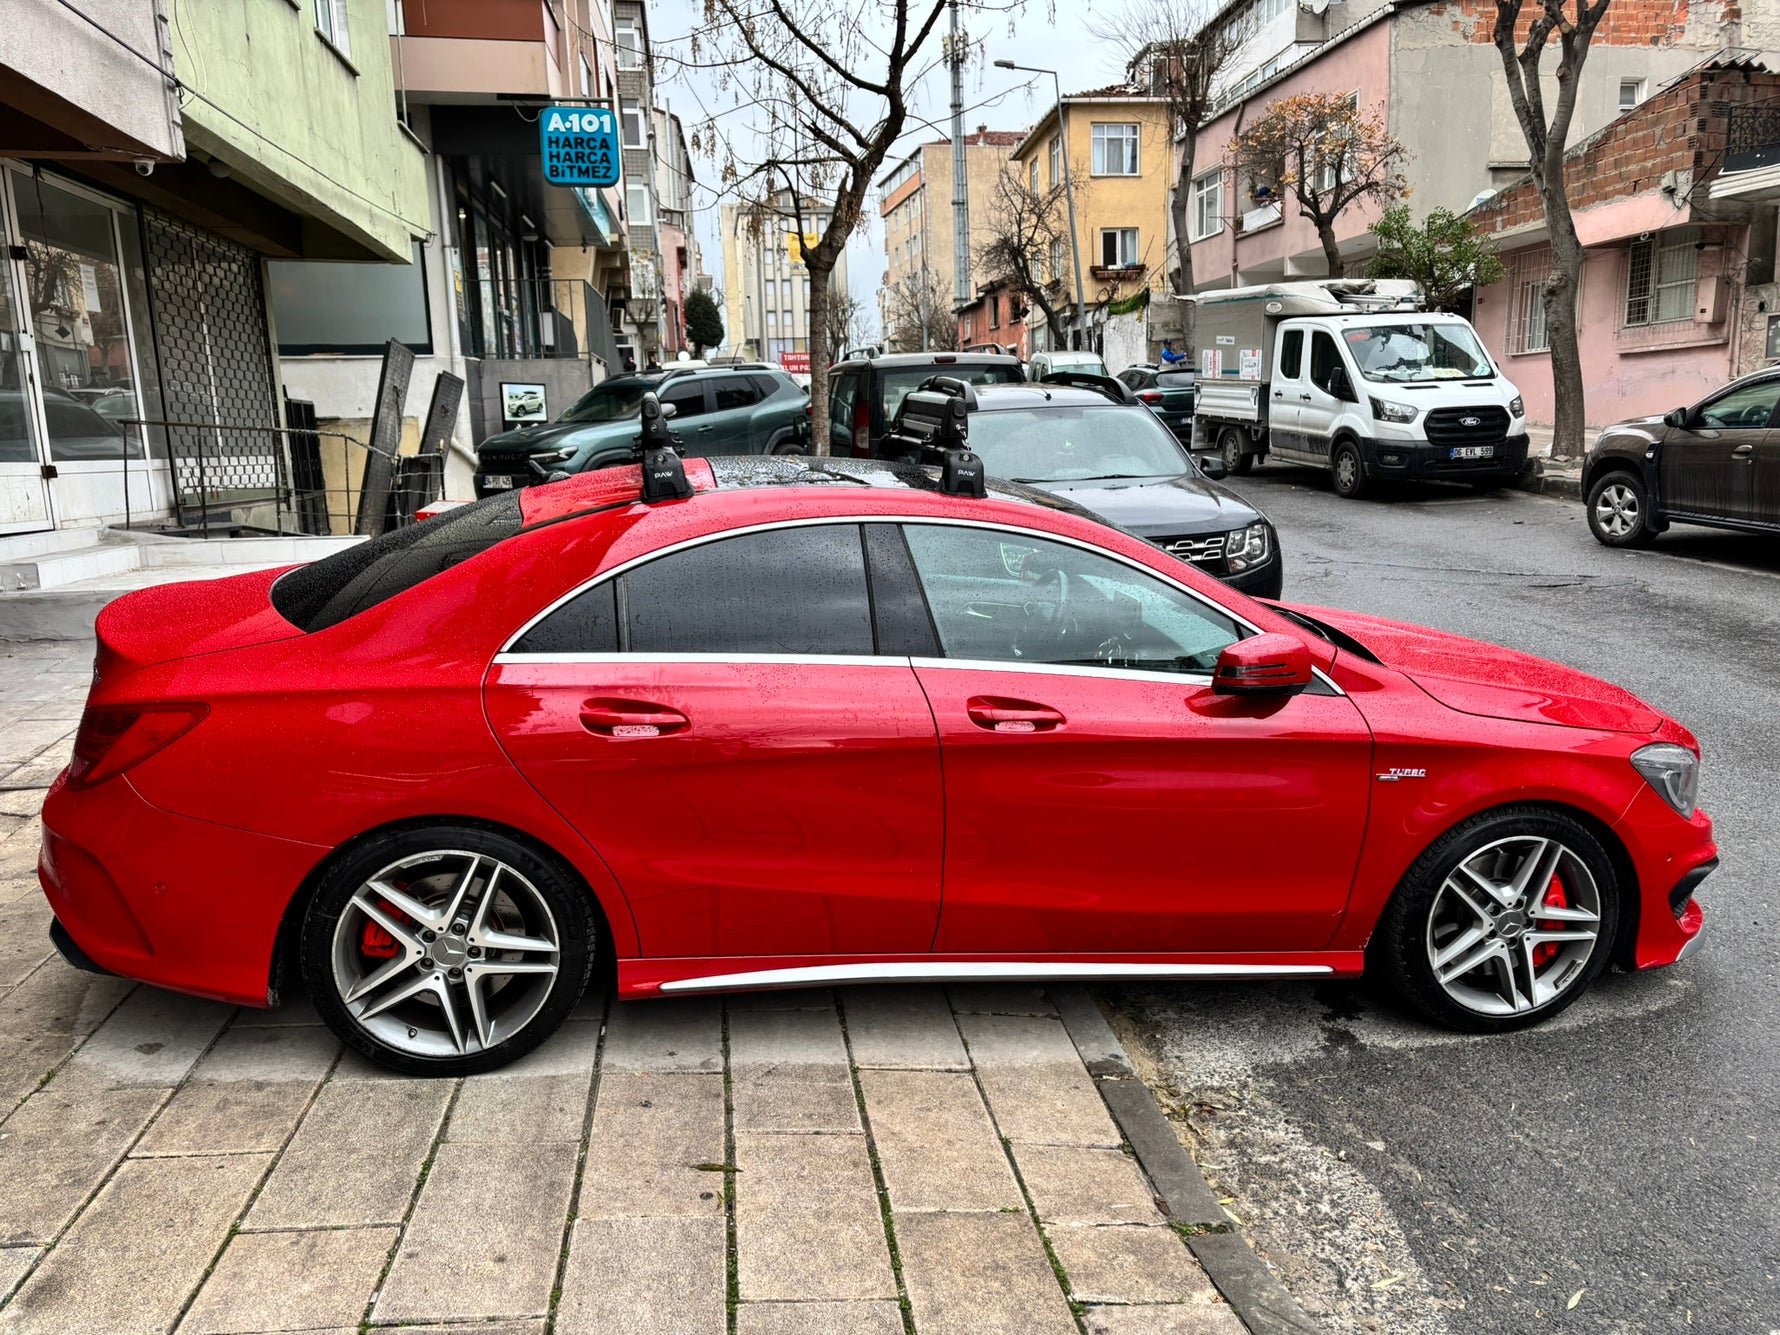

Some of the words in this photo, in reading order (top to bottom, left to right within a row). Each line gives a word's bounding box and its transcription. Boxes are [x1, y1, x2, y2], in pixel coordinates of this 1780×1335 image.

[548, 136, 611, 151] HARCA
[549, 151, 611, 164] HARCA
[1462, 417, 1478, 426] Ford
[1389, 768, 1426, 777] TURBO
